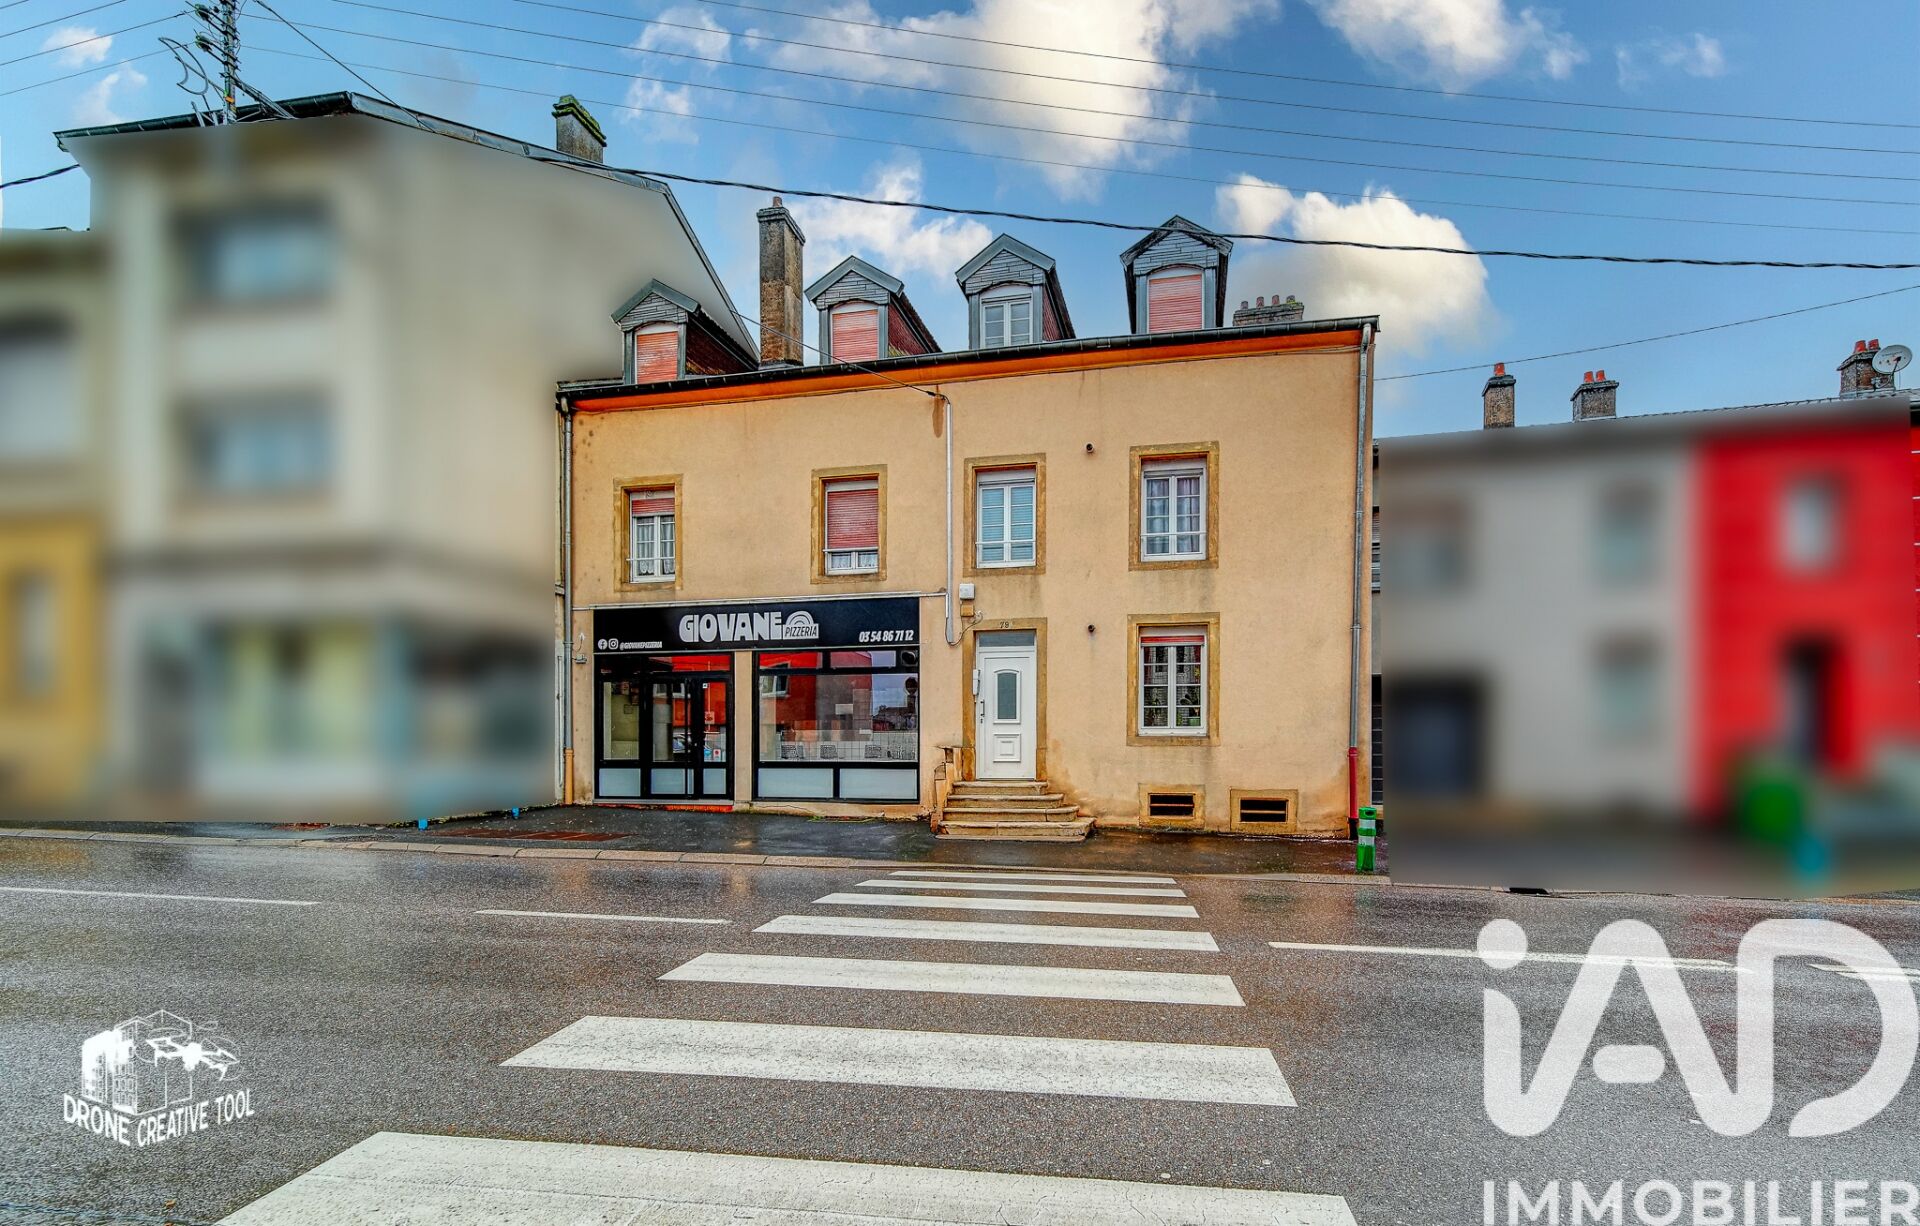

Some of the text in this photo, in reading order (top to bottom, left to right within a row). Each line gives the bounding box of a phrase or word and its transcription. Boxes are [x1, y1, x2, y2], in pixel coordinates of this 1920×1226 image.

[679, 611, 782, 643] GIOVANE
[784, 625, 817, 638] PIZZERIA
[1000, 621, 1009, 629] 79
[859, 629, 914, 643] 03 54 86 71 12
